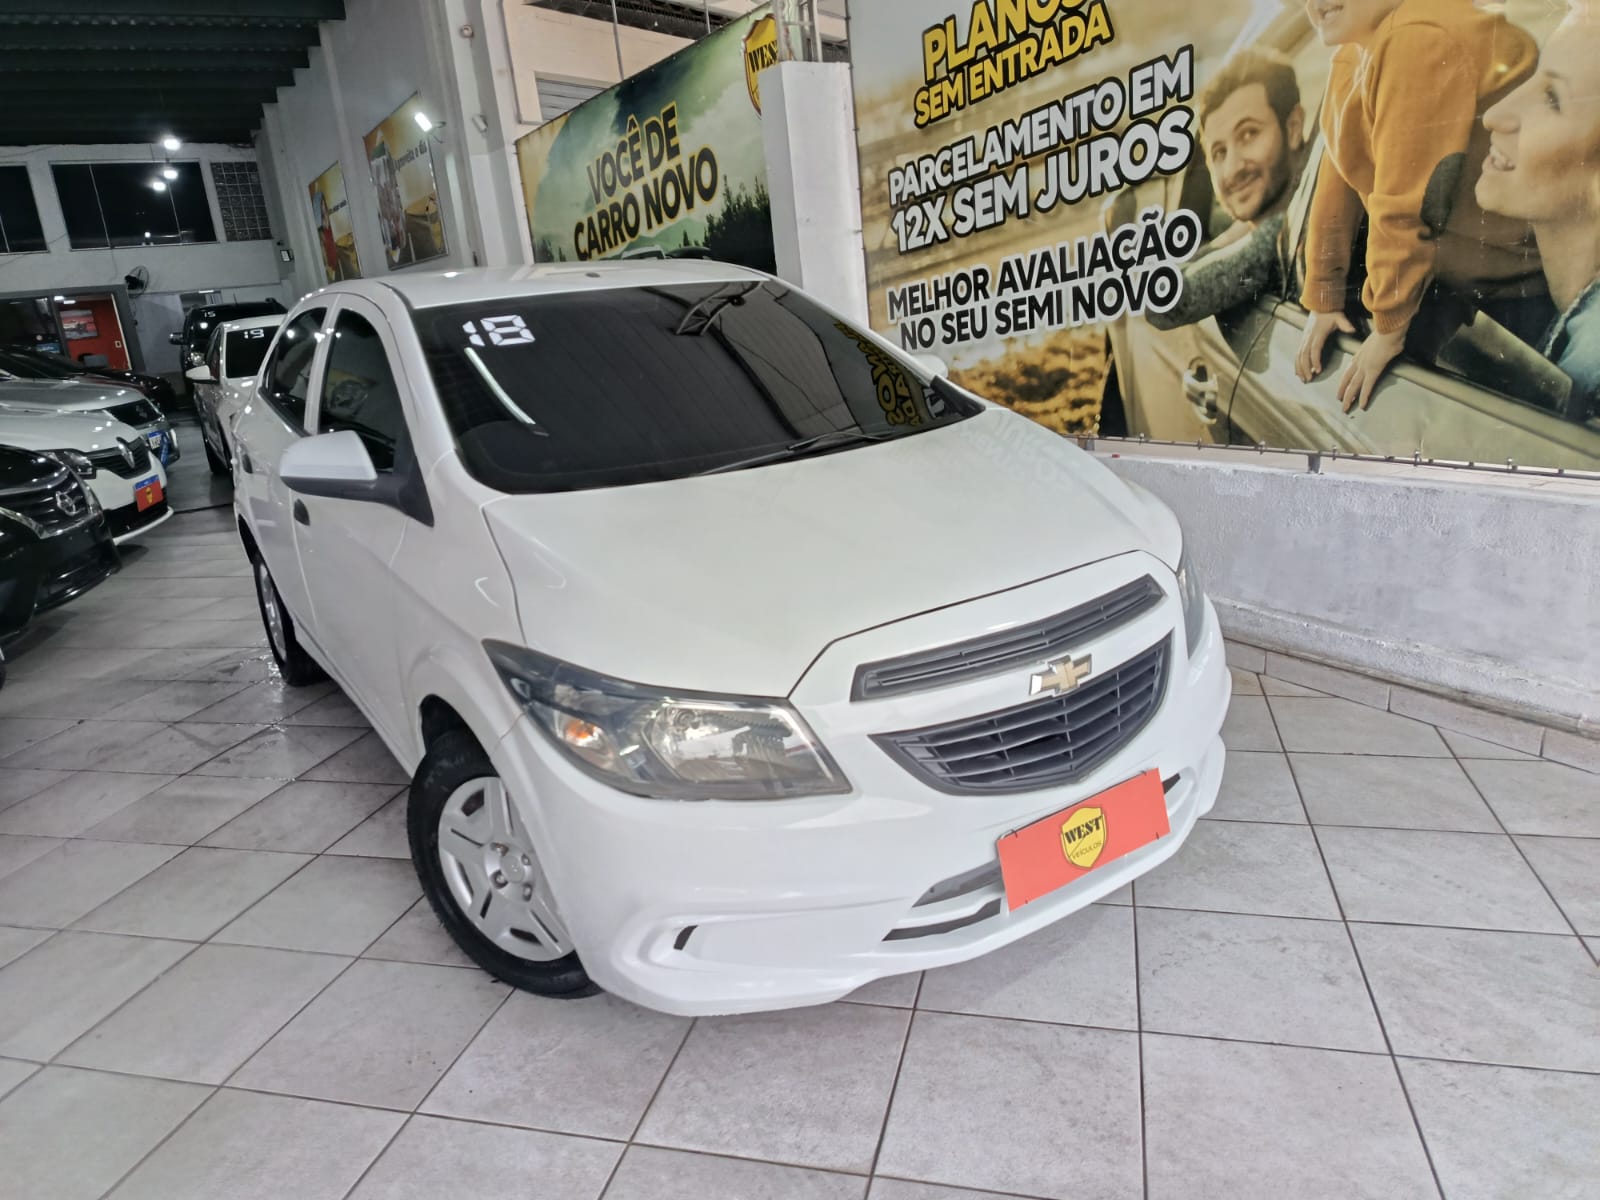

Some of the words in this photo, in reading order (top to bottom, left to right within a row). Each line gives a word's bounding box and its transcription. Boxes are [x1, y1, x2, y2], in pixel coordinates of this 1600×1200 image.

[749, 40, 777, 73] WES
[914, 72, 965, 126] SEM
[968, 3, 1112, 102] ENTRADA
[923, 0, 1080, 81] PLAN
[586, 115, 644, 204] VOCÊ
[644, 105, 680, 172] DE
[889, 78, 1125, 204] PARCELAMENTO
[1131, 46, 1194, 117] EM
[574, 193, 640, 261] CARRO
[644, 148, 719, 230] NOVO
[891, 196, 949, 254] 12X
[953, 165, 1029, 237] SEM
[1036, 107, 1194, 211] JUROS
[889, 268, 990, 320] MELHOR
[998, 211, 1197, 297] AVALIAÇÃO
[901, 318, 936, 350] NO
[942, 306, 988, 344] SEU
[995, 288, 1063, 335] SEMI
[1072, 267, 1180, 322] NOVO
[462, 315, 536, 347] 18
[1065, 816, 1103, 844] WEST
